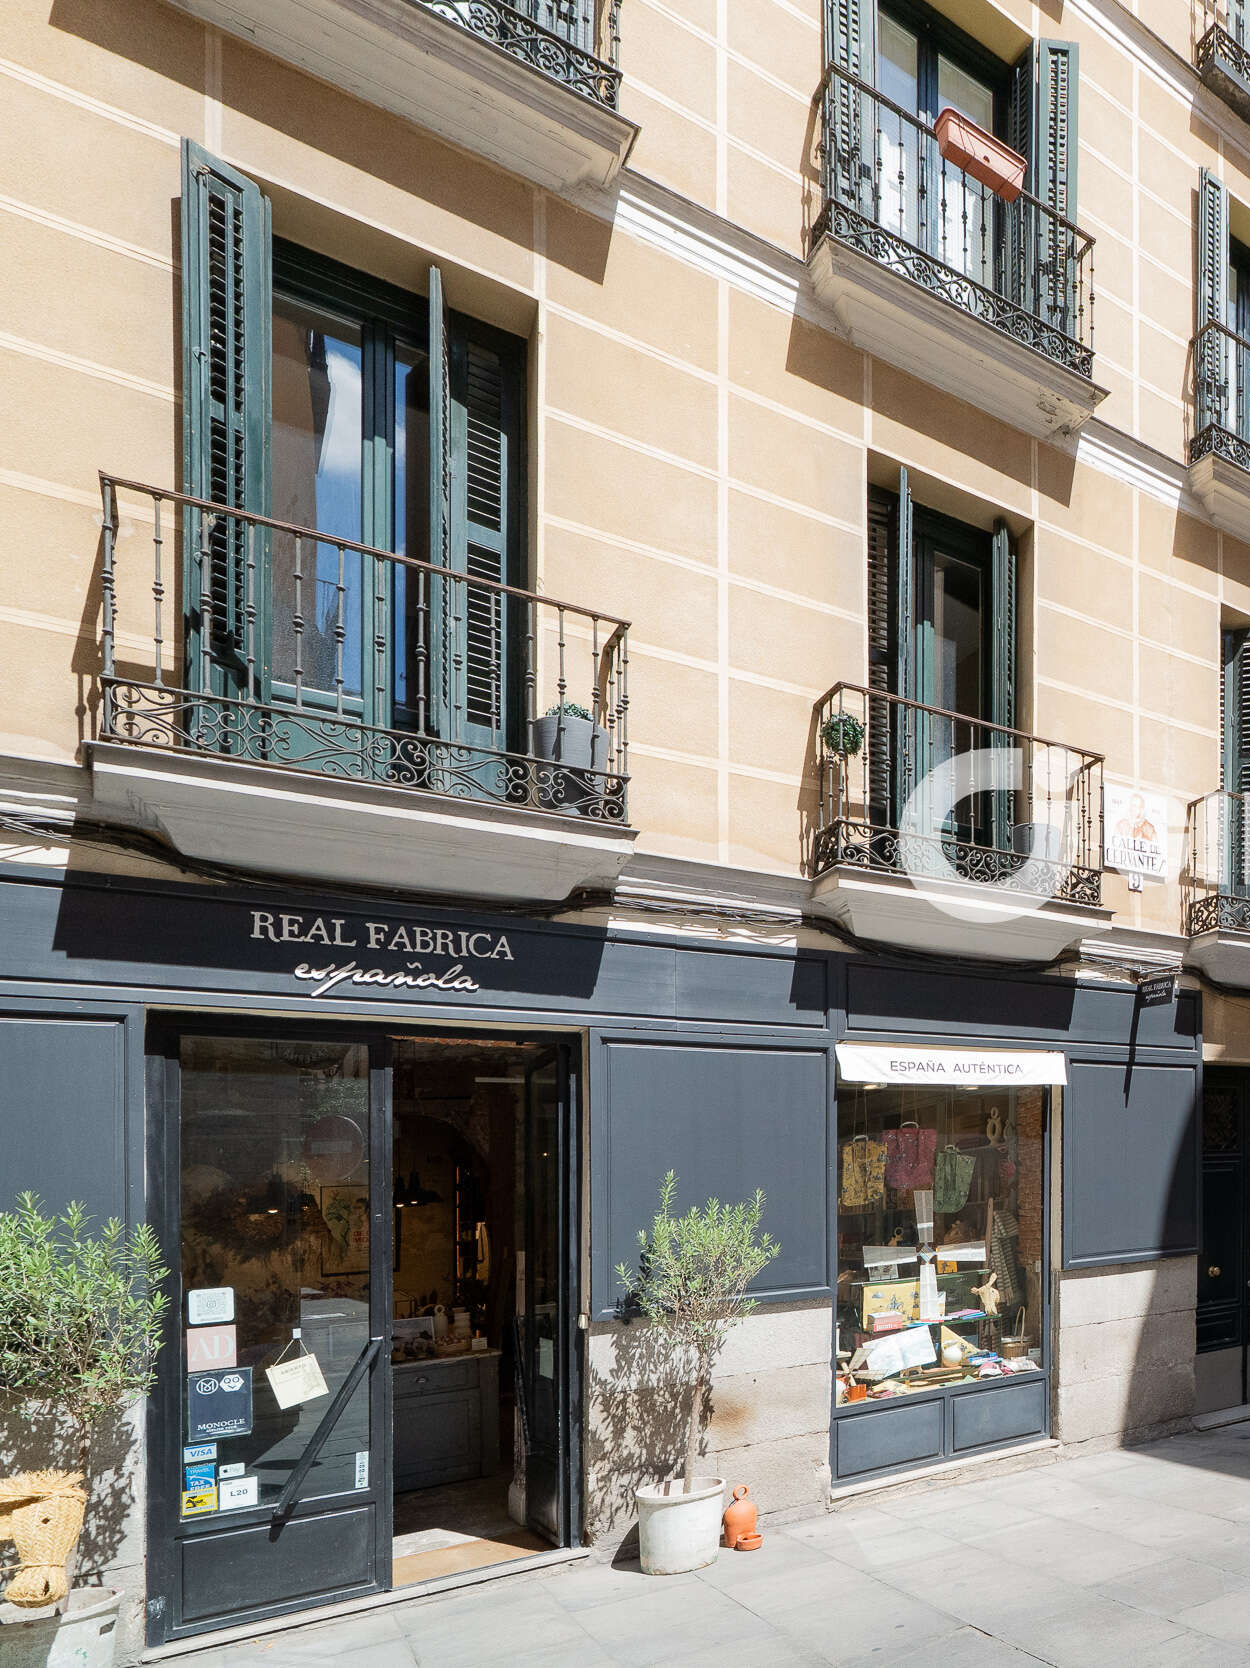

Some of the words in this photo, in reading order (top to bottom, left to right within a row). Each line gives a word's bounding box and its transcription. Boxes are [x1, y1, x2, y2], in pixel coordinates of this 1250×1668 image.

[1111, 836, 1147, 853] CALLE
[1149, 844, 1161, 855] DE
[250, 911, 357, 947] REAL
[365, 922, 515, 960] FABRICA
[294, 960, 480, 997] española
[890, 1059, 946, 1073] ESPAÑA
[953, 1061, 1023, 1075] AUTÉNTICA
[191, 1335, 235, 1361] AD
[197, 1418, 246, 1431] MONOCLE
[189, 1448, 213, 1458] VISA
